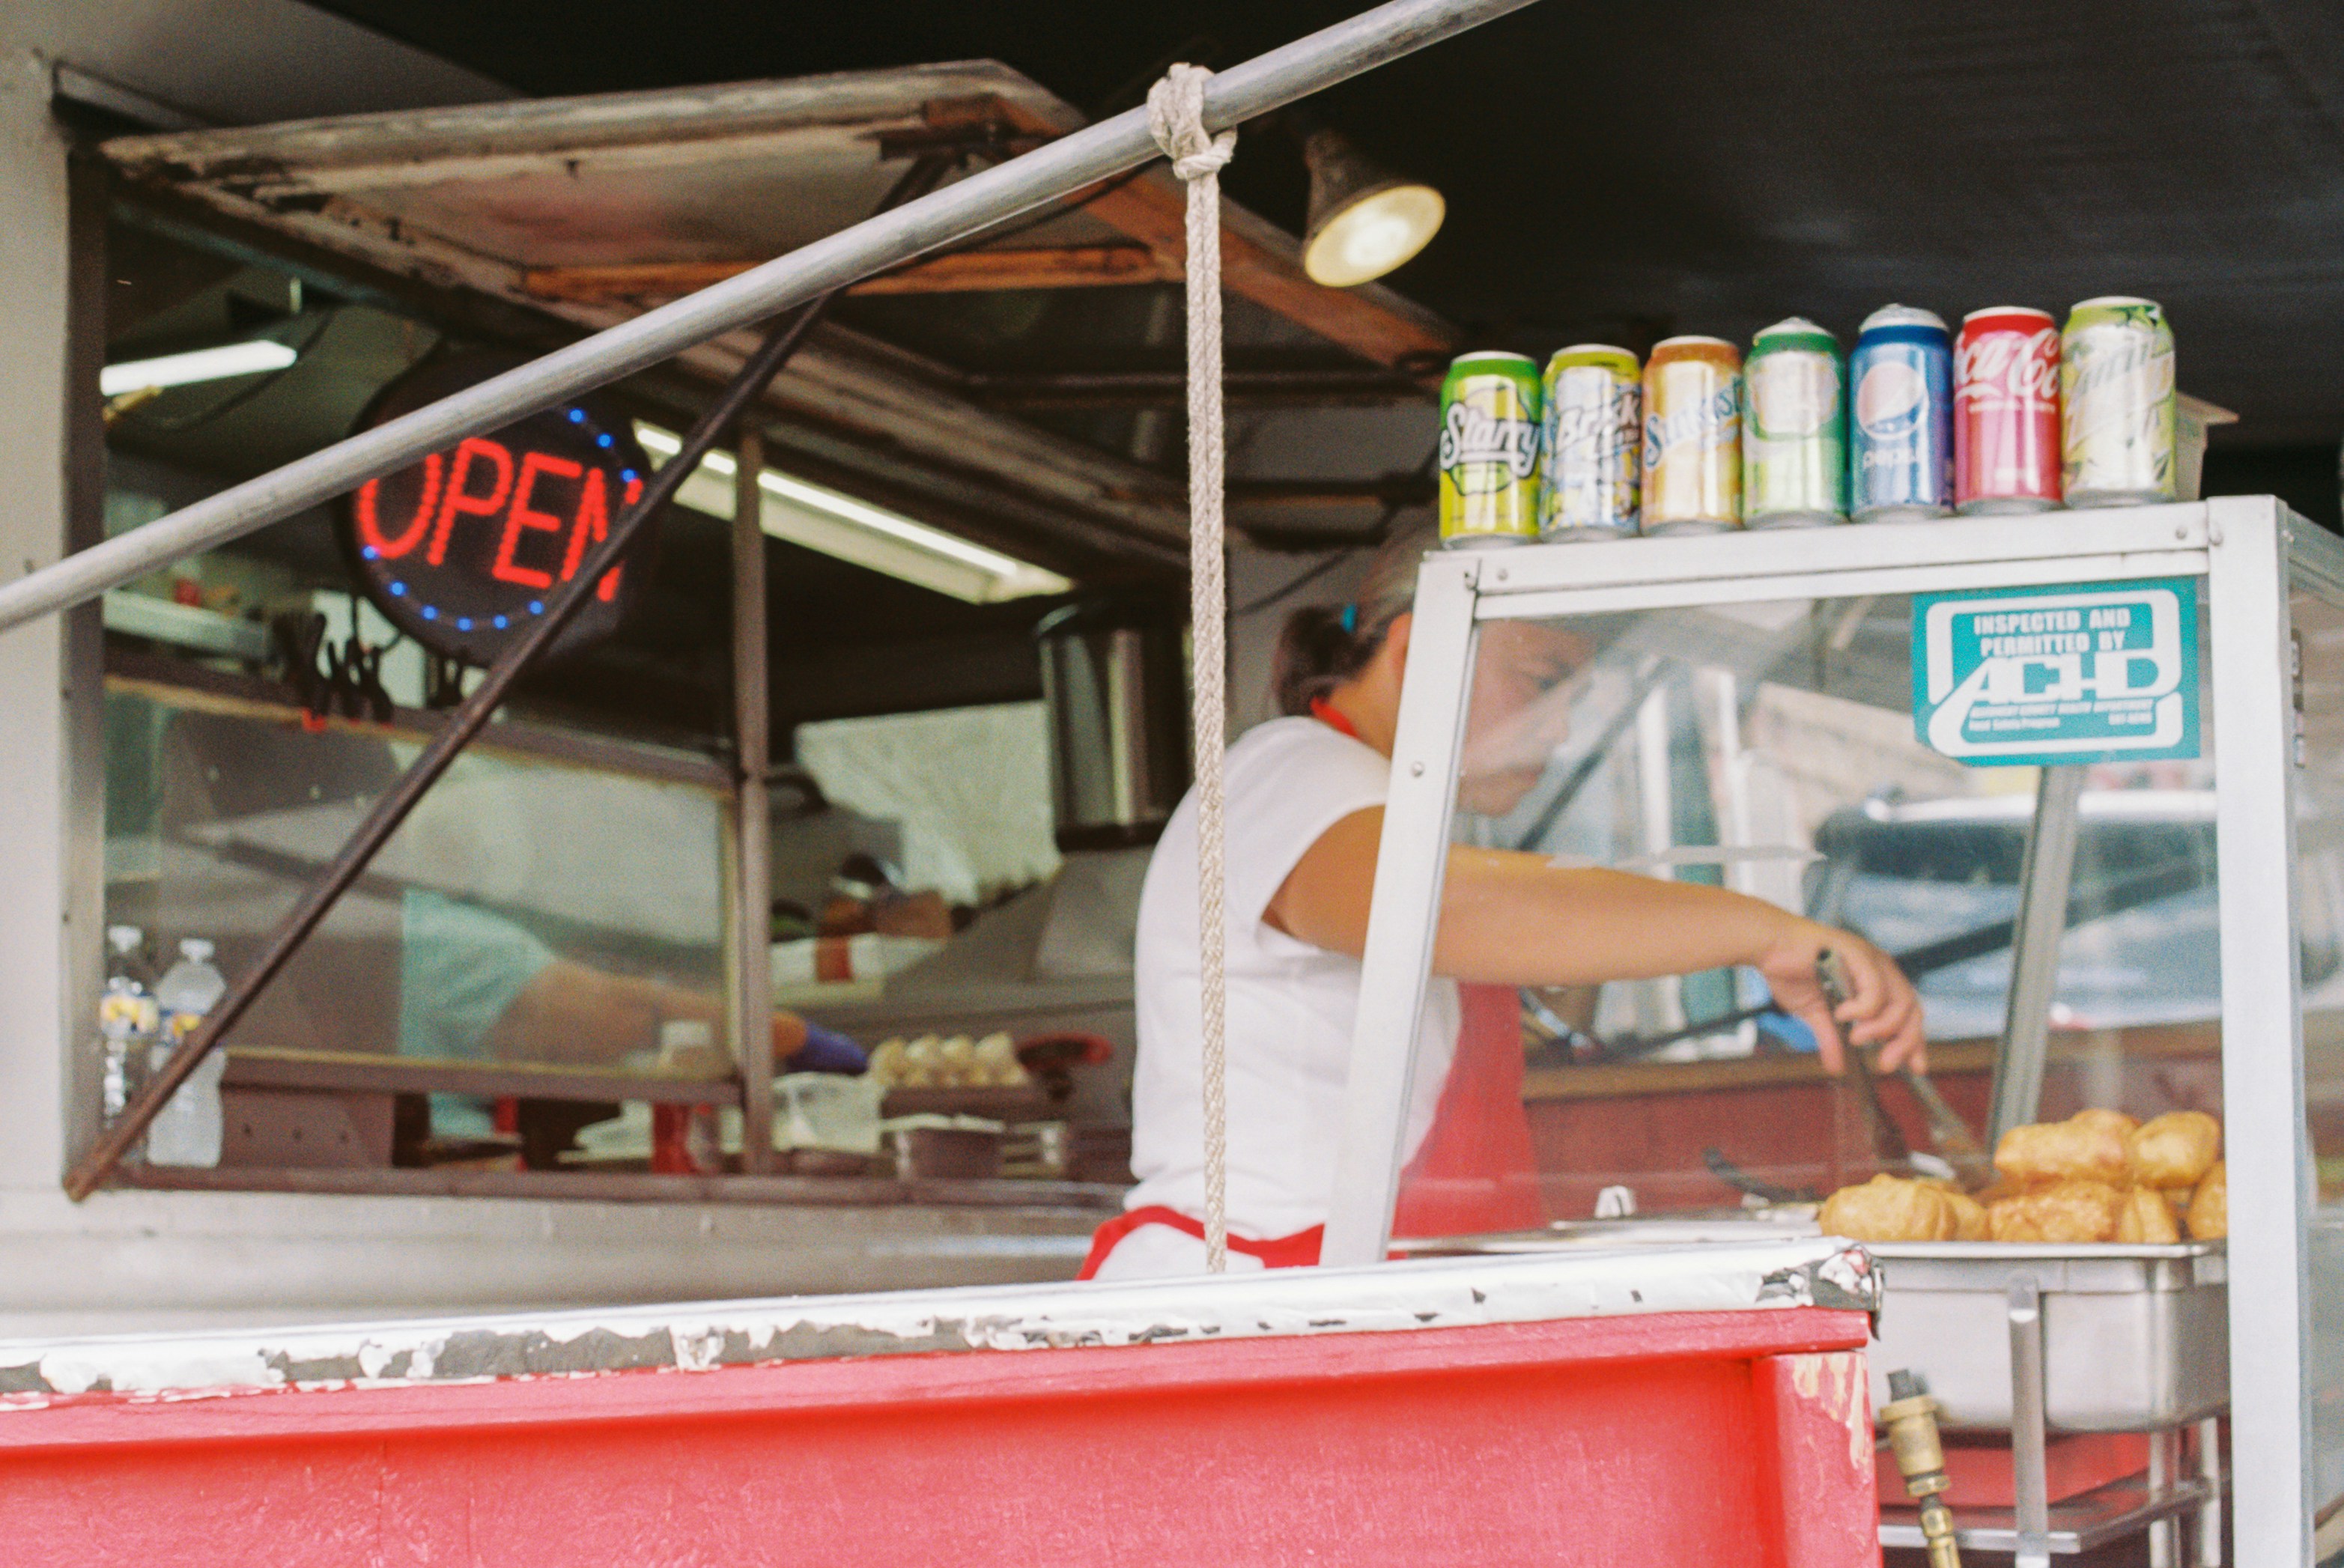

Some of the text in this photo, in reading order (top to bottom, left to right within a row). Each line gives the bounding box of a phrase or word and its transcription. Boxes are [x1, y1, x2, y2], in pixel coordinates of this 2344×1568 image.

[359, 436, 643, 602] OPEN
[1973, 607, 2131, 636] INSPECTED AND
[1980, 630, 2125, 658] PERMITTED BY
[1952, 650, 2182, 705] ACHD
